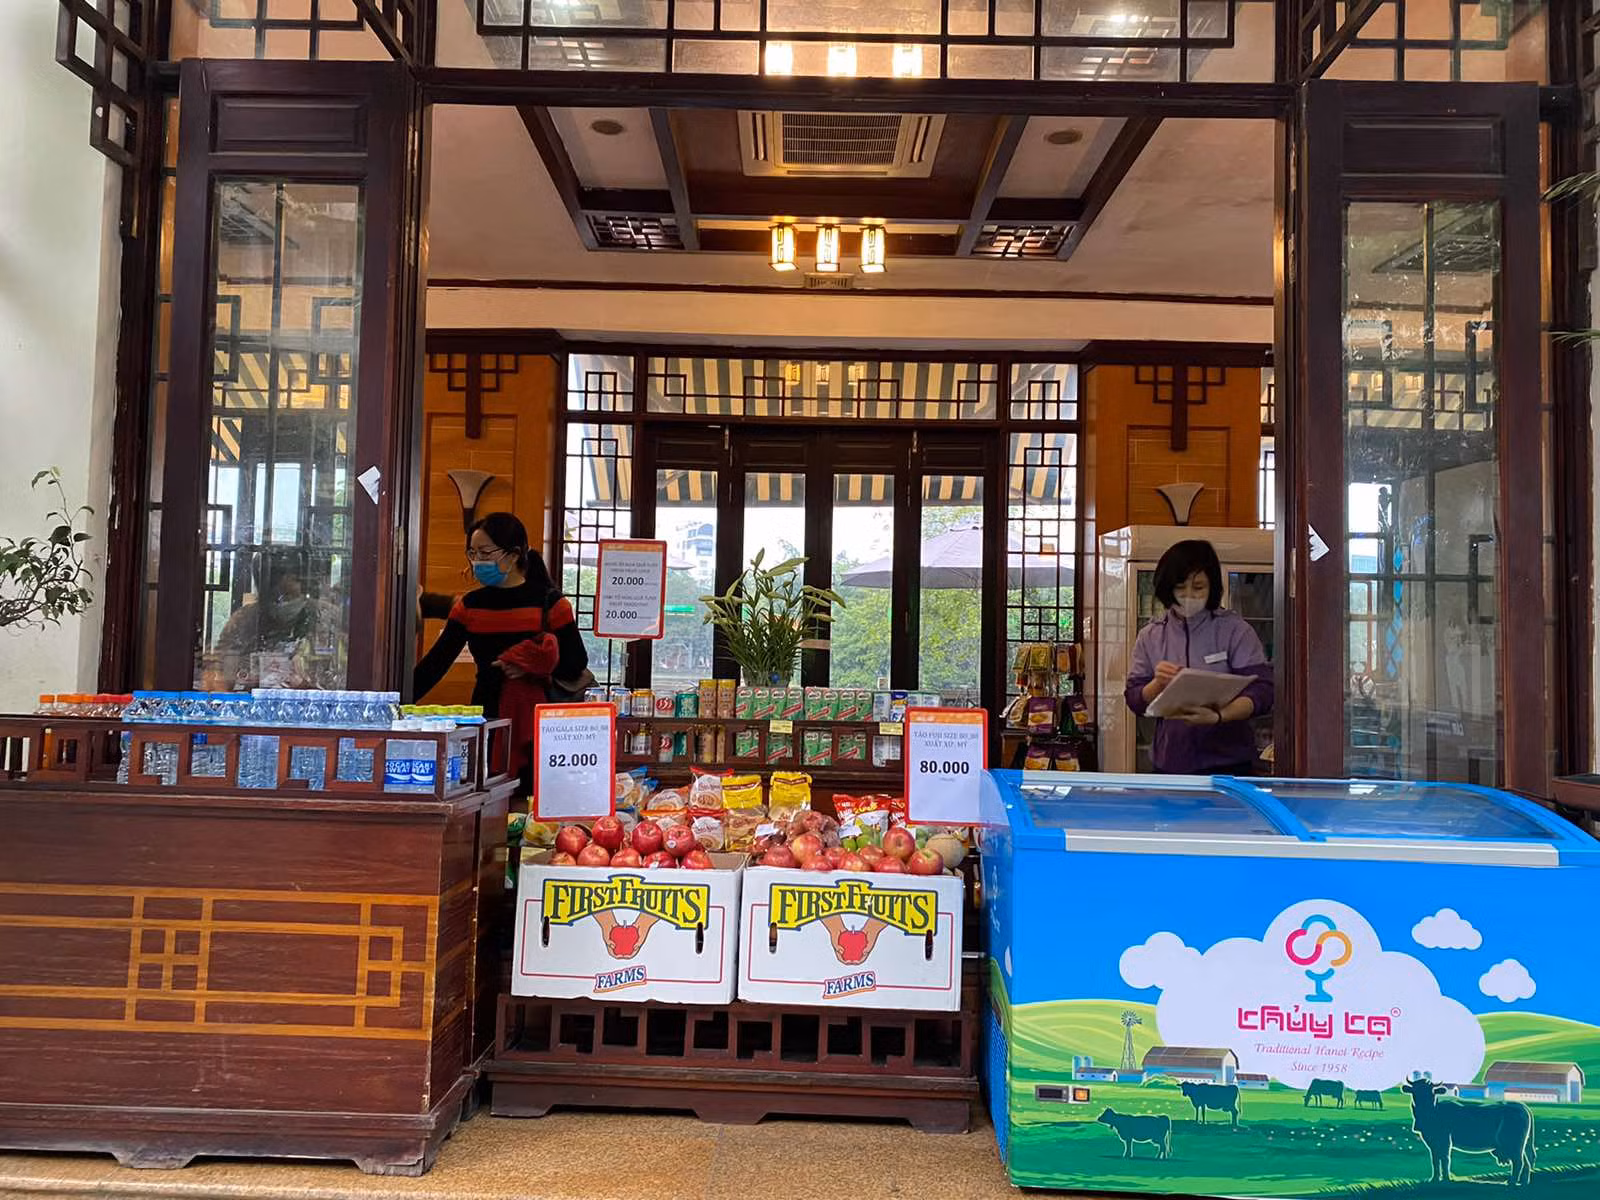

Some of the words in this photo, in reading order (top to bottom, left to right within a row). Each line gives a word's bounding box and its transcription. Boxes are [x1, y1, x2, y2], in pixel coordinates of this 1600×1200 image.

[611, 576, 645, 586] 20.000
[605, 610, 638, 619] 20.000
[549, 753, 598, 768] 82.000
[919, 760, 970, 775] 80.000
[596, 966, 646, 989] FARMS
[825, 974, 875, 995] FARMS
[1254, 1043, 1312, 1055] Traditional
[1315, 1045, 1348, 1057] Hanoi
[1350, 1047, 1385, 1061] Recipe
[1291, 1062, 1317, 1073] Since
[1322, 1063, 1348, 1073] 1958
